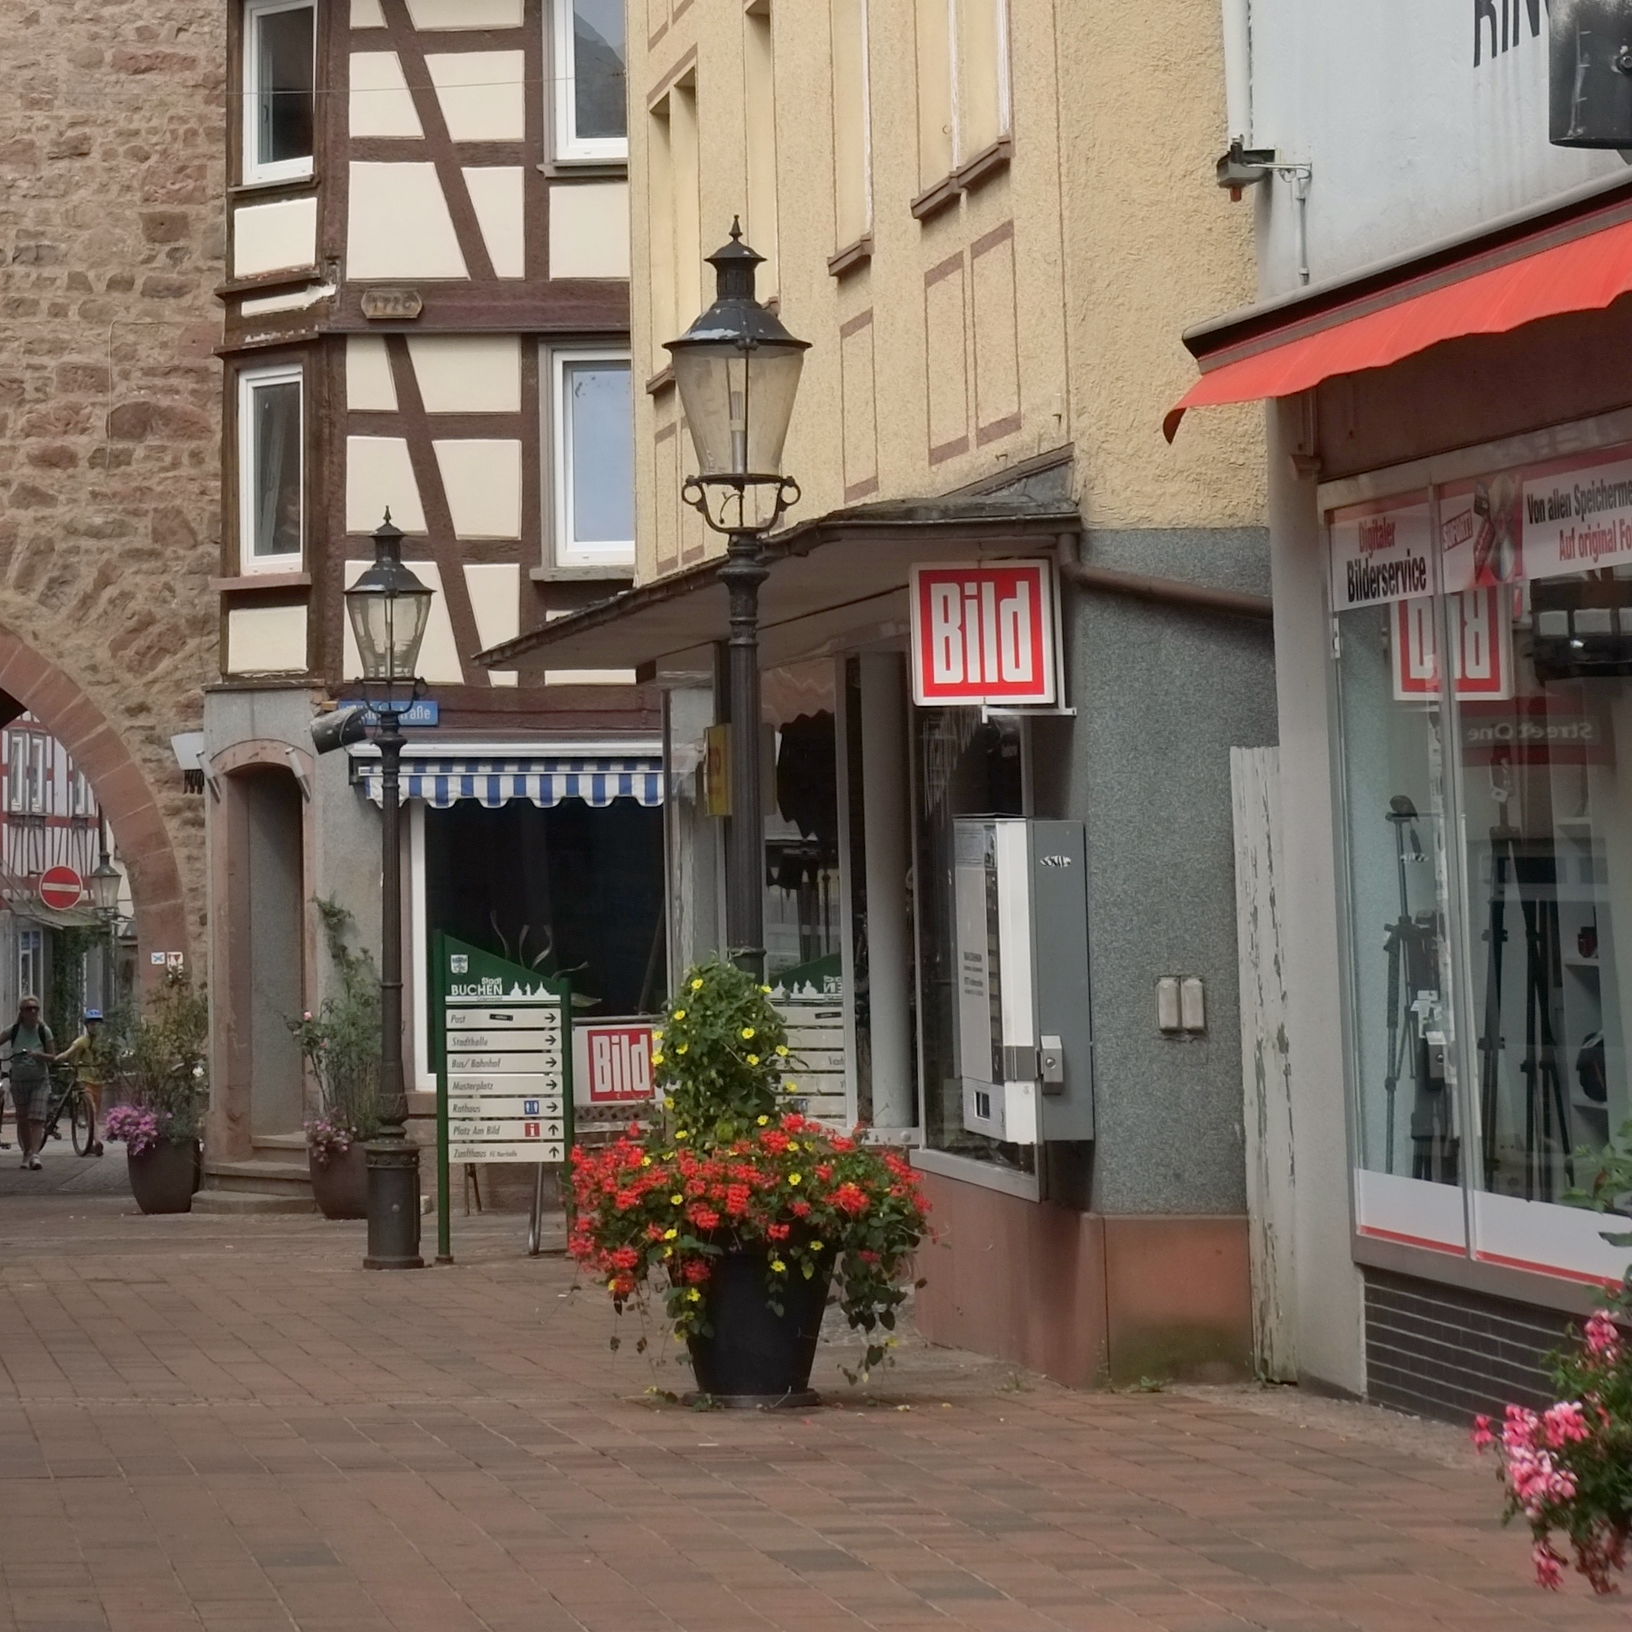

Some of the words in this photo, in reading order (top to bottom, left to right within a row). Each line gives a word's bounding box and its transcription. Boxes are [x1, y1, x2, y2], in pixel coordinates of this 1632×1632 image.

[1527, 492, 1546, 525] Von
[1548, 487, 1572, 522] allen
[1358, 515, 1396, 558] Digitaler
[1559, 525, 1577, 561] Auf
[1578, 519, 1617, 563] original
[1346, 548, 1427, 603] Bilderservice
[931, 581, 1033, 684] Bild
[451, 984, 503, 996] BUCHEN
[450, 1015, 466, 1024] Post
[592, 1034, 650, 1093] Bild
